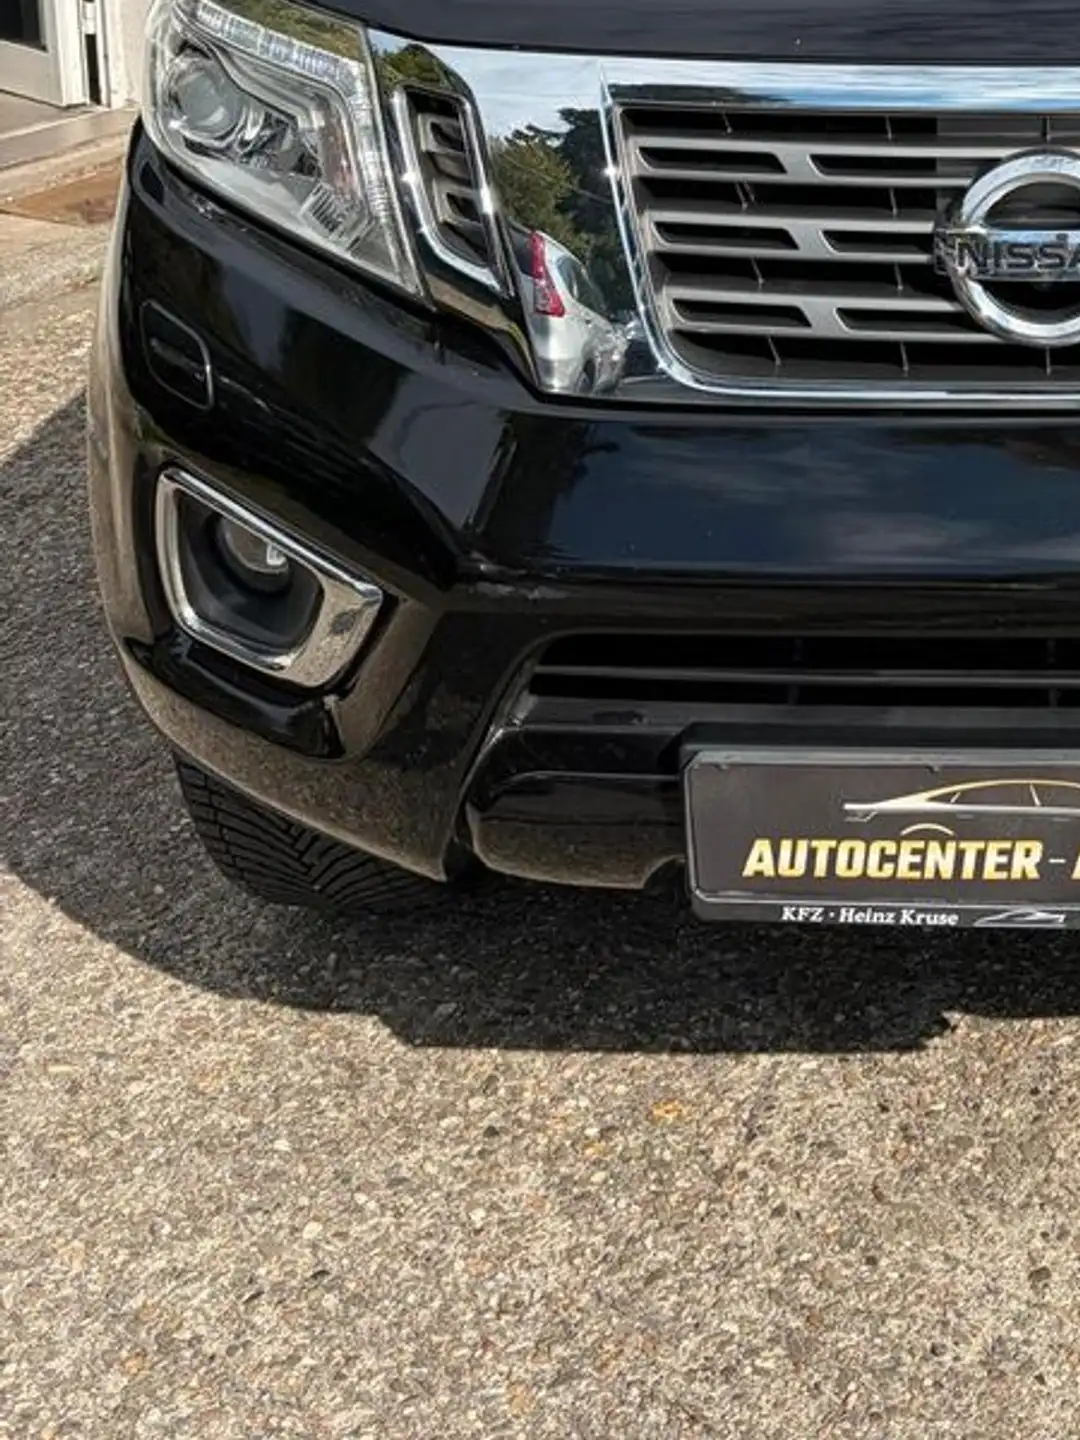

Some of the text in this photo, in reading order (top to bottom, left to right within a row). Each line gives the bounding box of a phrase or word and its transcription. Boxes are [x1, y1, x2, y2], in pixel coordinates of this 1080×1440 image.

[741, 837, 1044, 881] AUTOCENTER
[781, 907, 824, 923] KFZ
[839, 908, 896, 924] Heinz
[900, 909, 960, 925] Kruse
